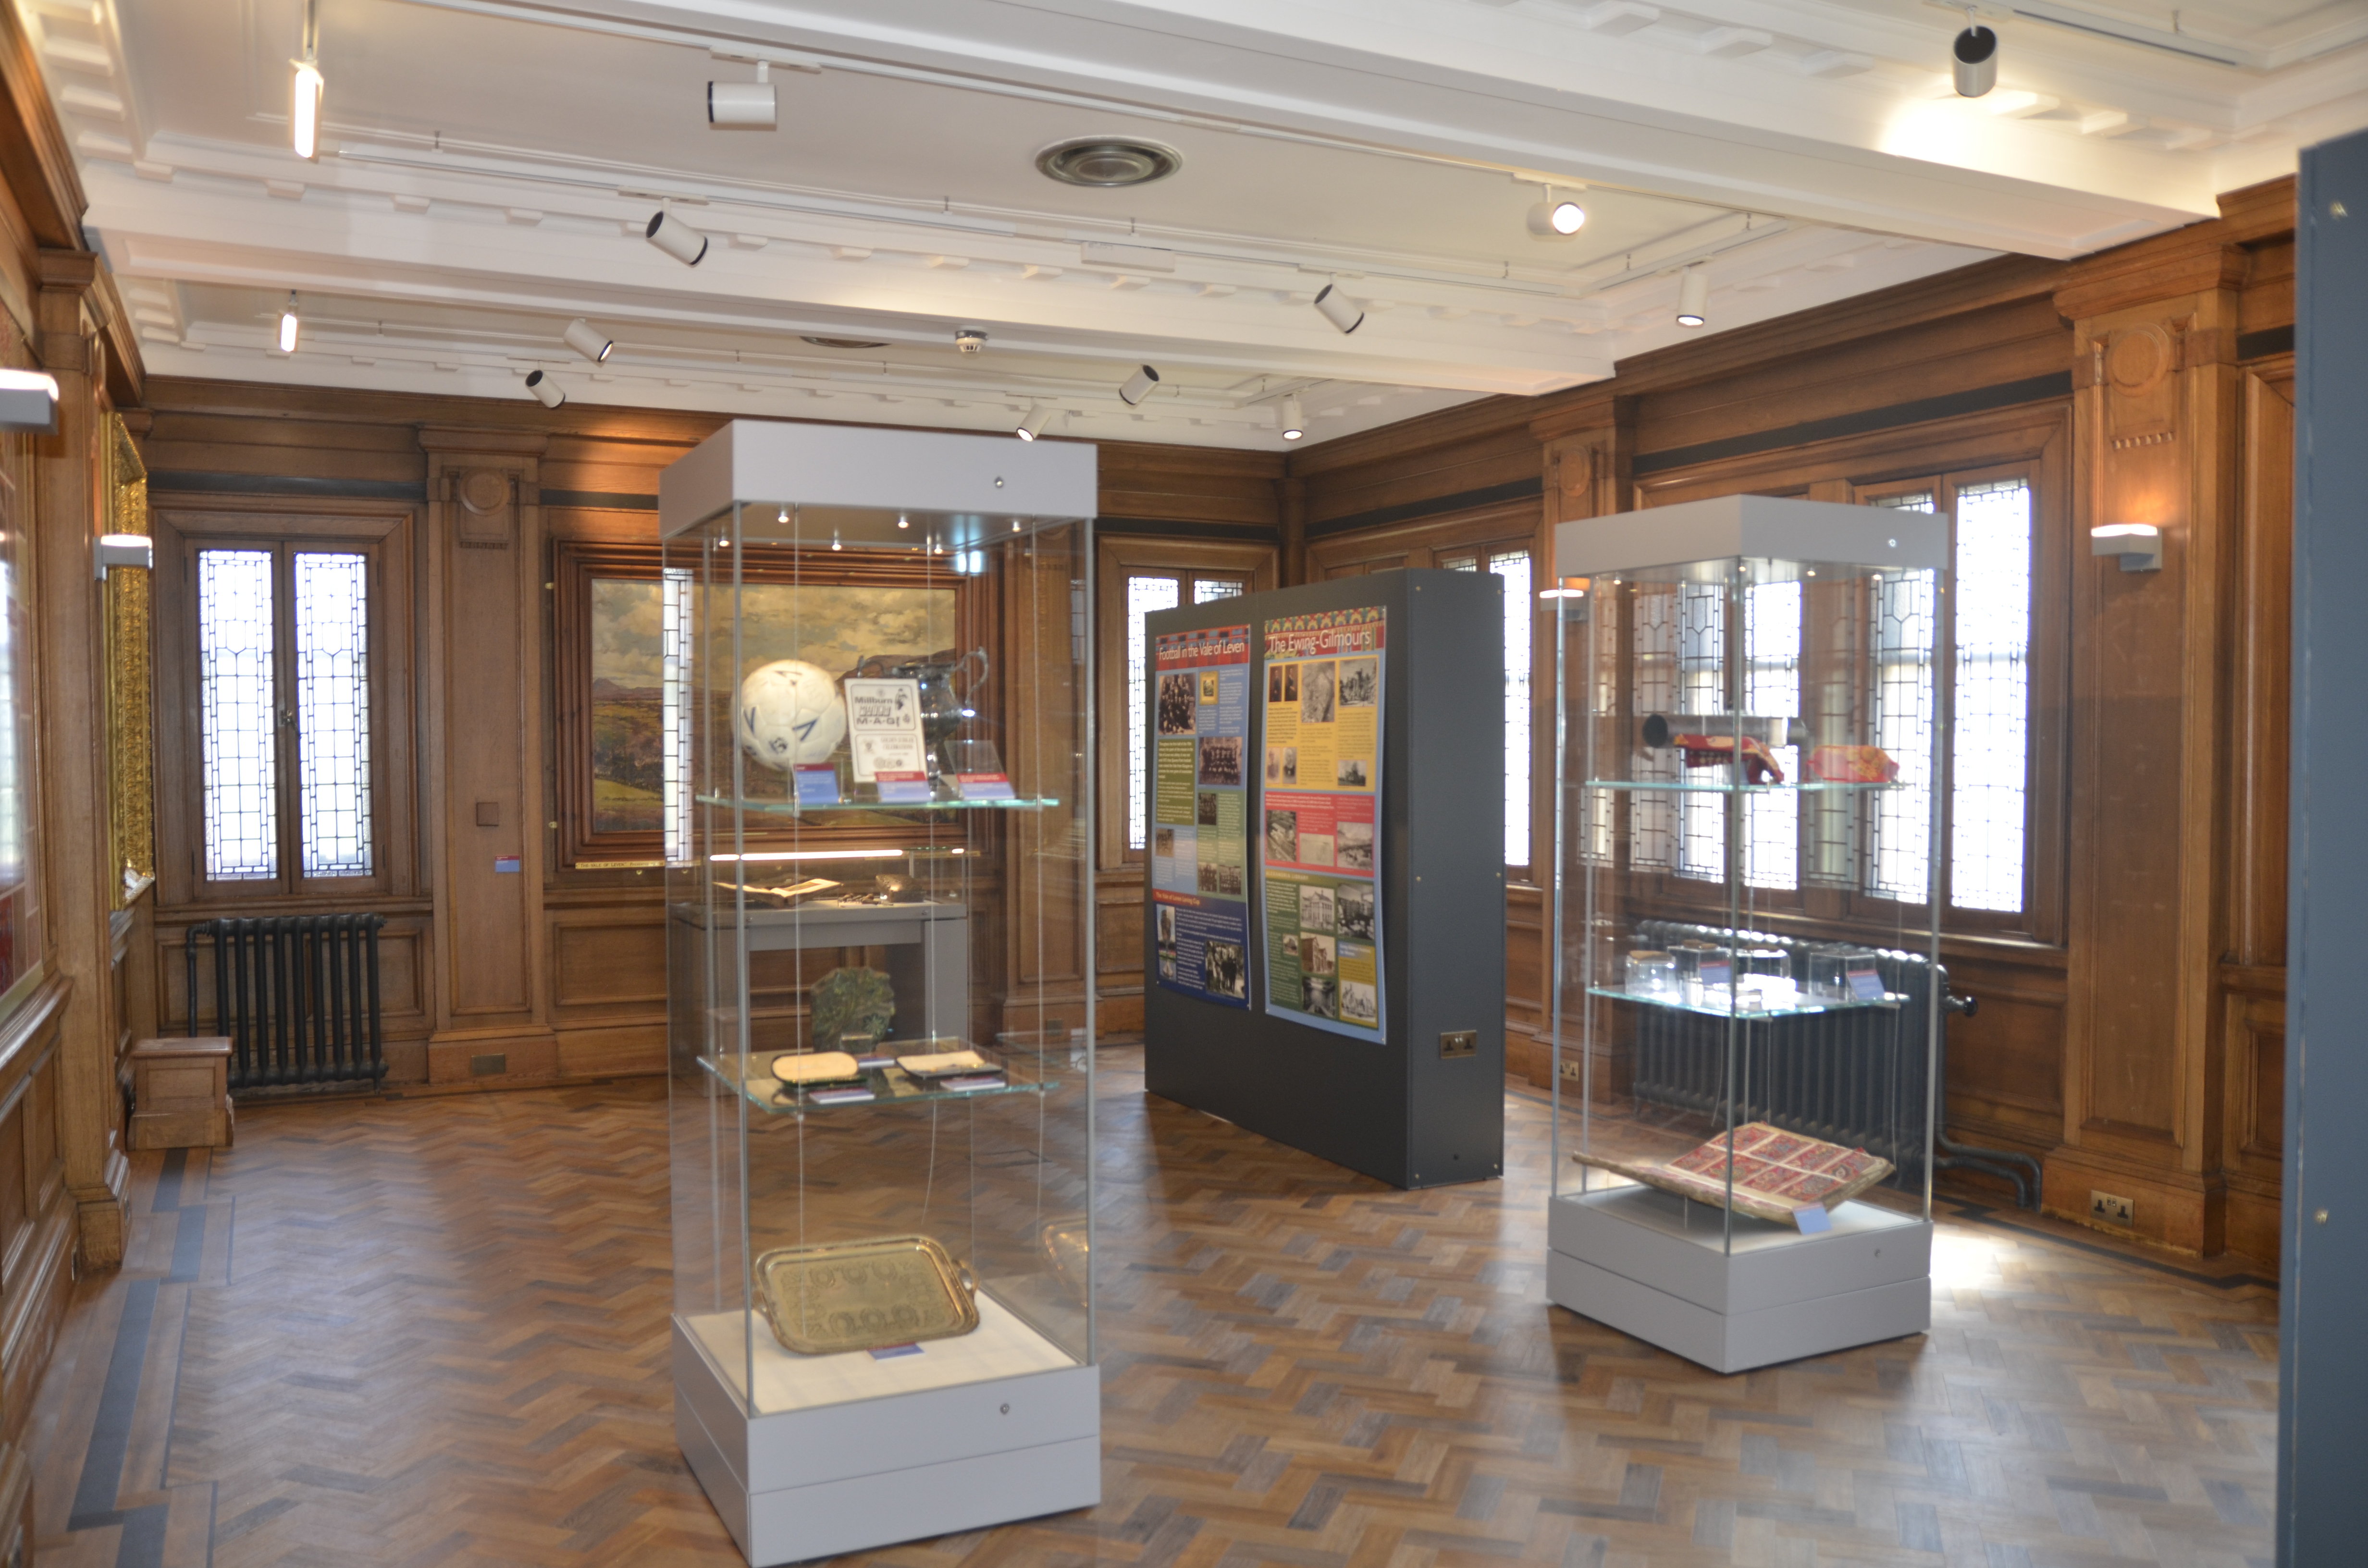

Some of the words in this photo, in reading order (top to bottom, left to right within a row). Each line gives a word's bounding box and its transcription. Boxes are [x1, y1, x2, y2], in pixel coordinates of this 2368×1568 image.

[1159, 646, 1181, 661] Football
[1182, 646, 1187, 658] in
[1188, 644, 1198, 657] the
[1199, 642, 1212, 656] Vale
[1214, 640, 1222, 655] of
[1223, 639, 1245, 654] Leven
[1269, 636, 1286, 653] The
[1288, 629, 1370, 655] Ewing-Gilmours
